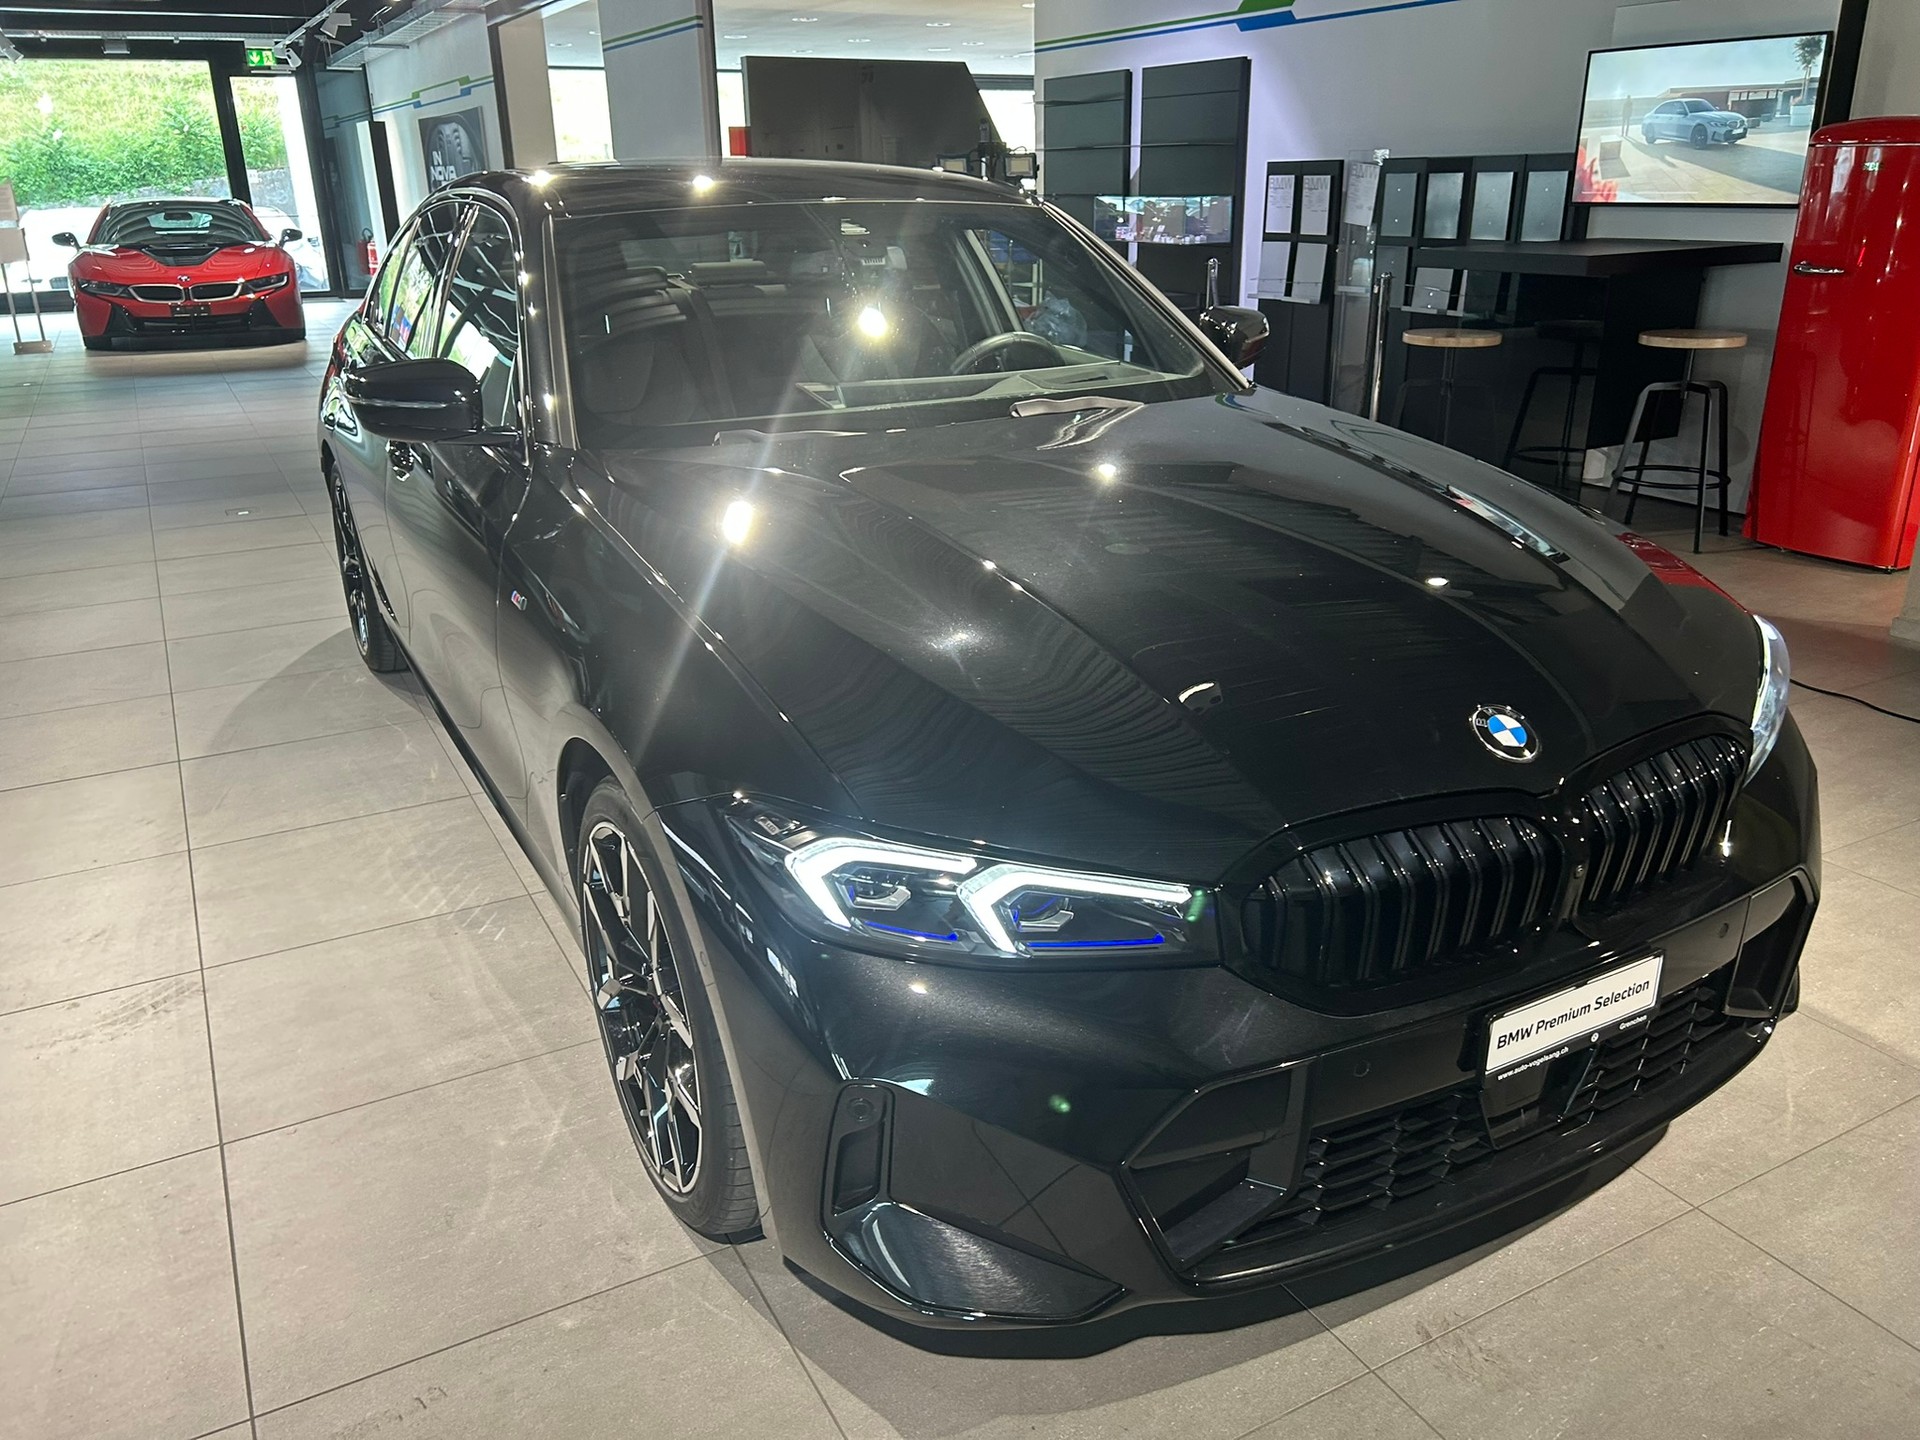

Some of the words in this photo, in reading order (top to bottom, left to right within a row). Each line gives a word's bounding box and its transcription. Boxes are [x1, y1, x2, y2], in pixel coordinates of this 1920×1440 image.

[432, 151, 443, 166] IN
[430, 165, 457, 181] NOVA
[1497, 1024, 1534, 1050] BMW
[1536, 1003, 1592, 1036] Premium
[1593, 979, 1650, 1011] Selection
[1619, 1014, 1648, 1030] Grenchen
[1497, 1046, 1569, 1081] www.auto-vogelsang.ch
